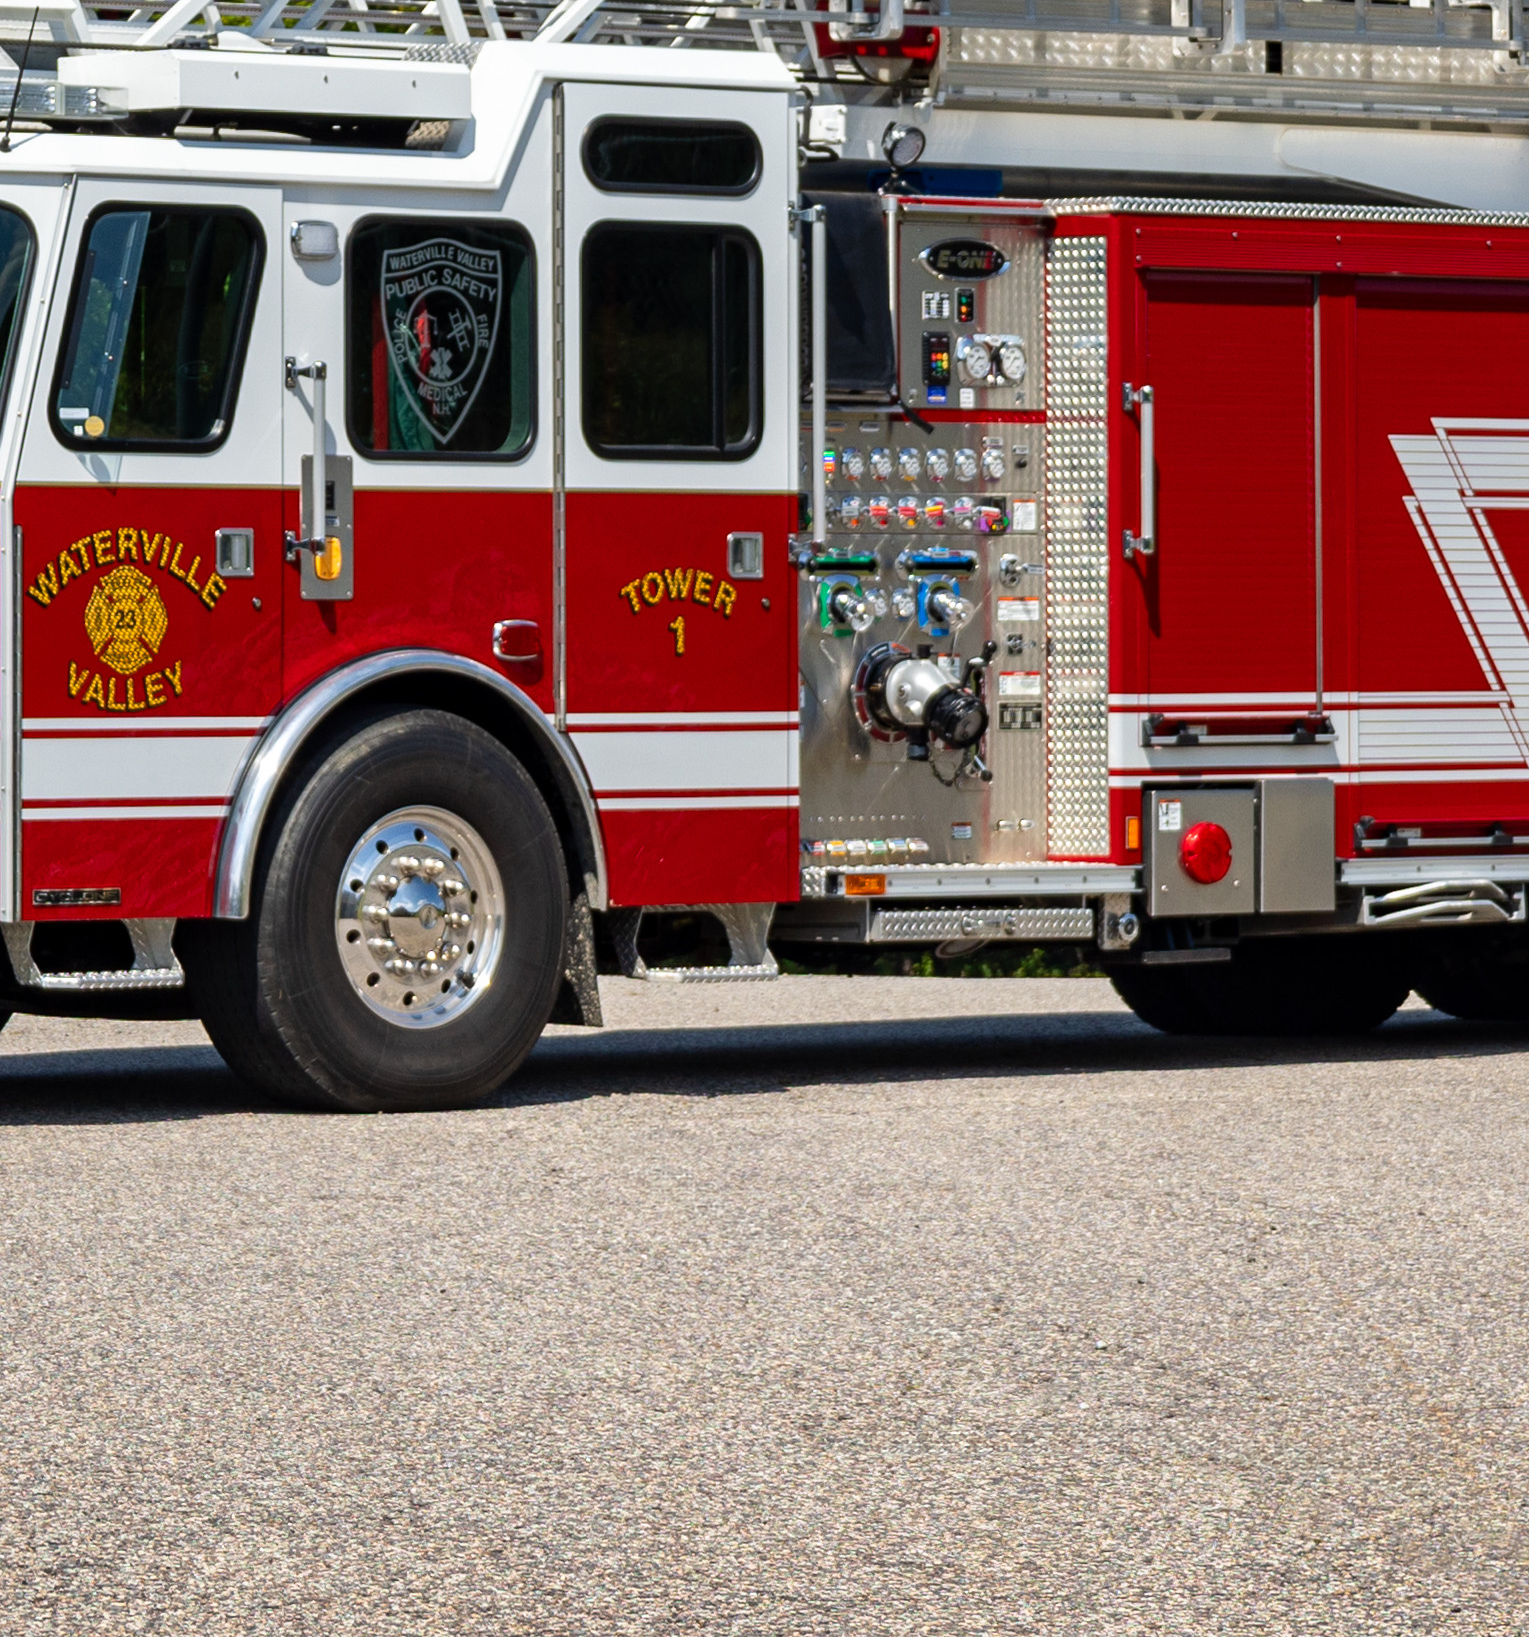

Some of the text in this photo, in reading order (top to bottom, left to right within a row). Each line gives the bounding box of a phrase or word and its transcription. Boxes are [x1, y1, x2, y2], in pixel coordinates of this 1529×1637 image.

[389, 246, 495, 272] WATERVILLE VALLEY
[937, 249, 997, 271] E-ONE
[385, 268, 498, 302] PUBLIC SAFETY
[393, 308, 408, 364] POLICE
[475, 313, 489, 349] FIRE
[417, 382, 468, 403] MEDICAL
[26, 527, 228, 612] WATERVILLE
[619, 567, 738, 619] TOWER
[115, 611, 137, 629] 23
[668, 615, 686, 656] 1
[68, 659, 184, 712] VALLEY
